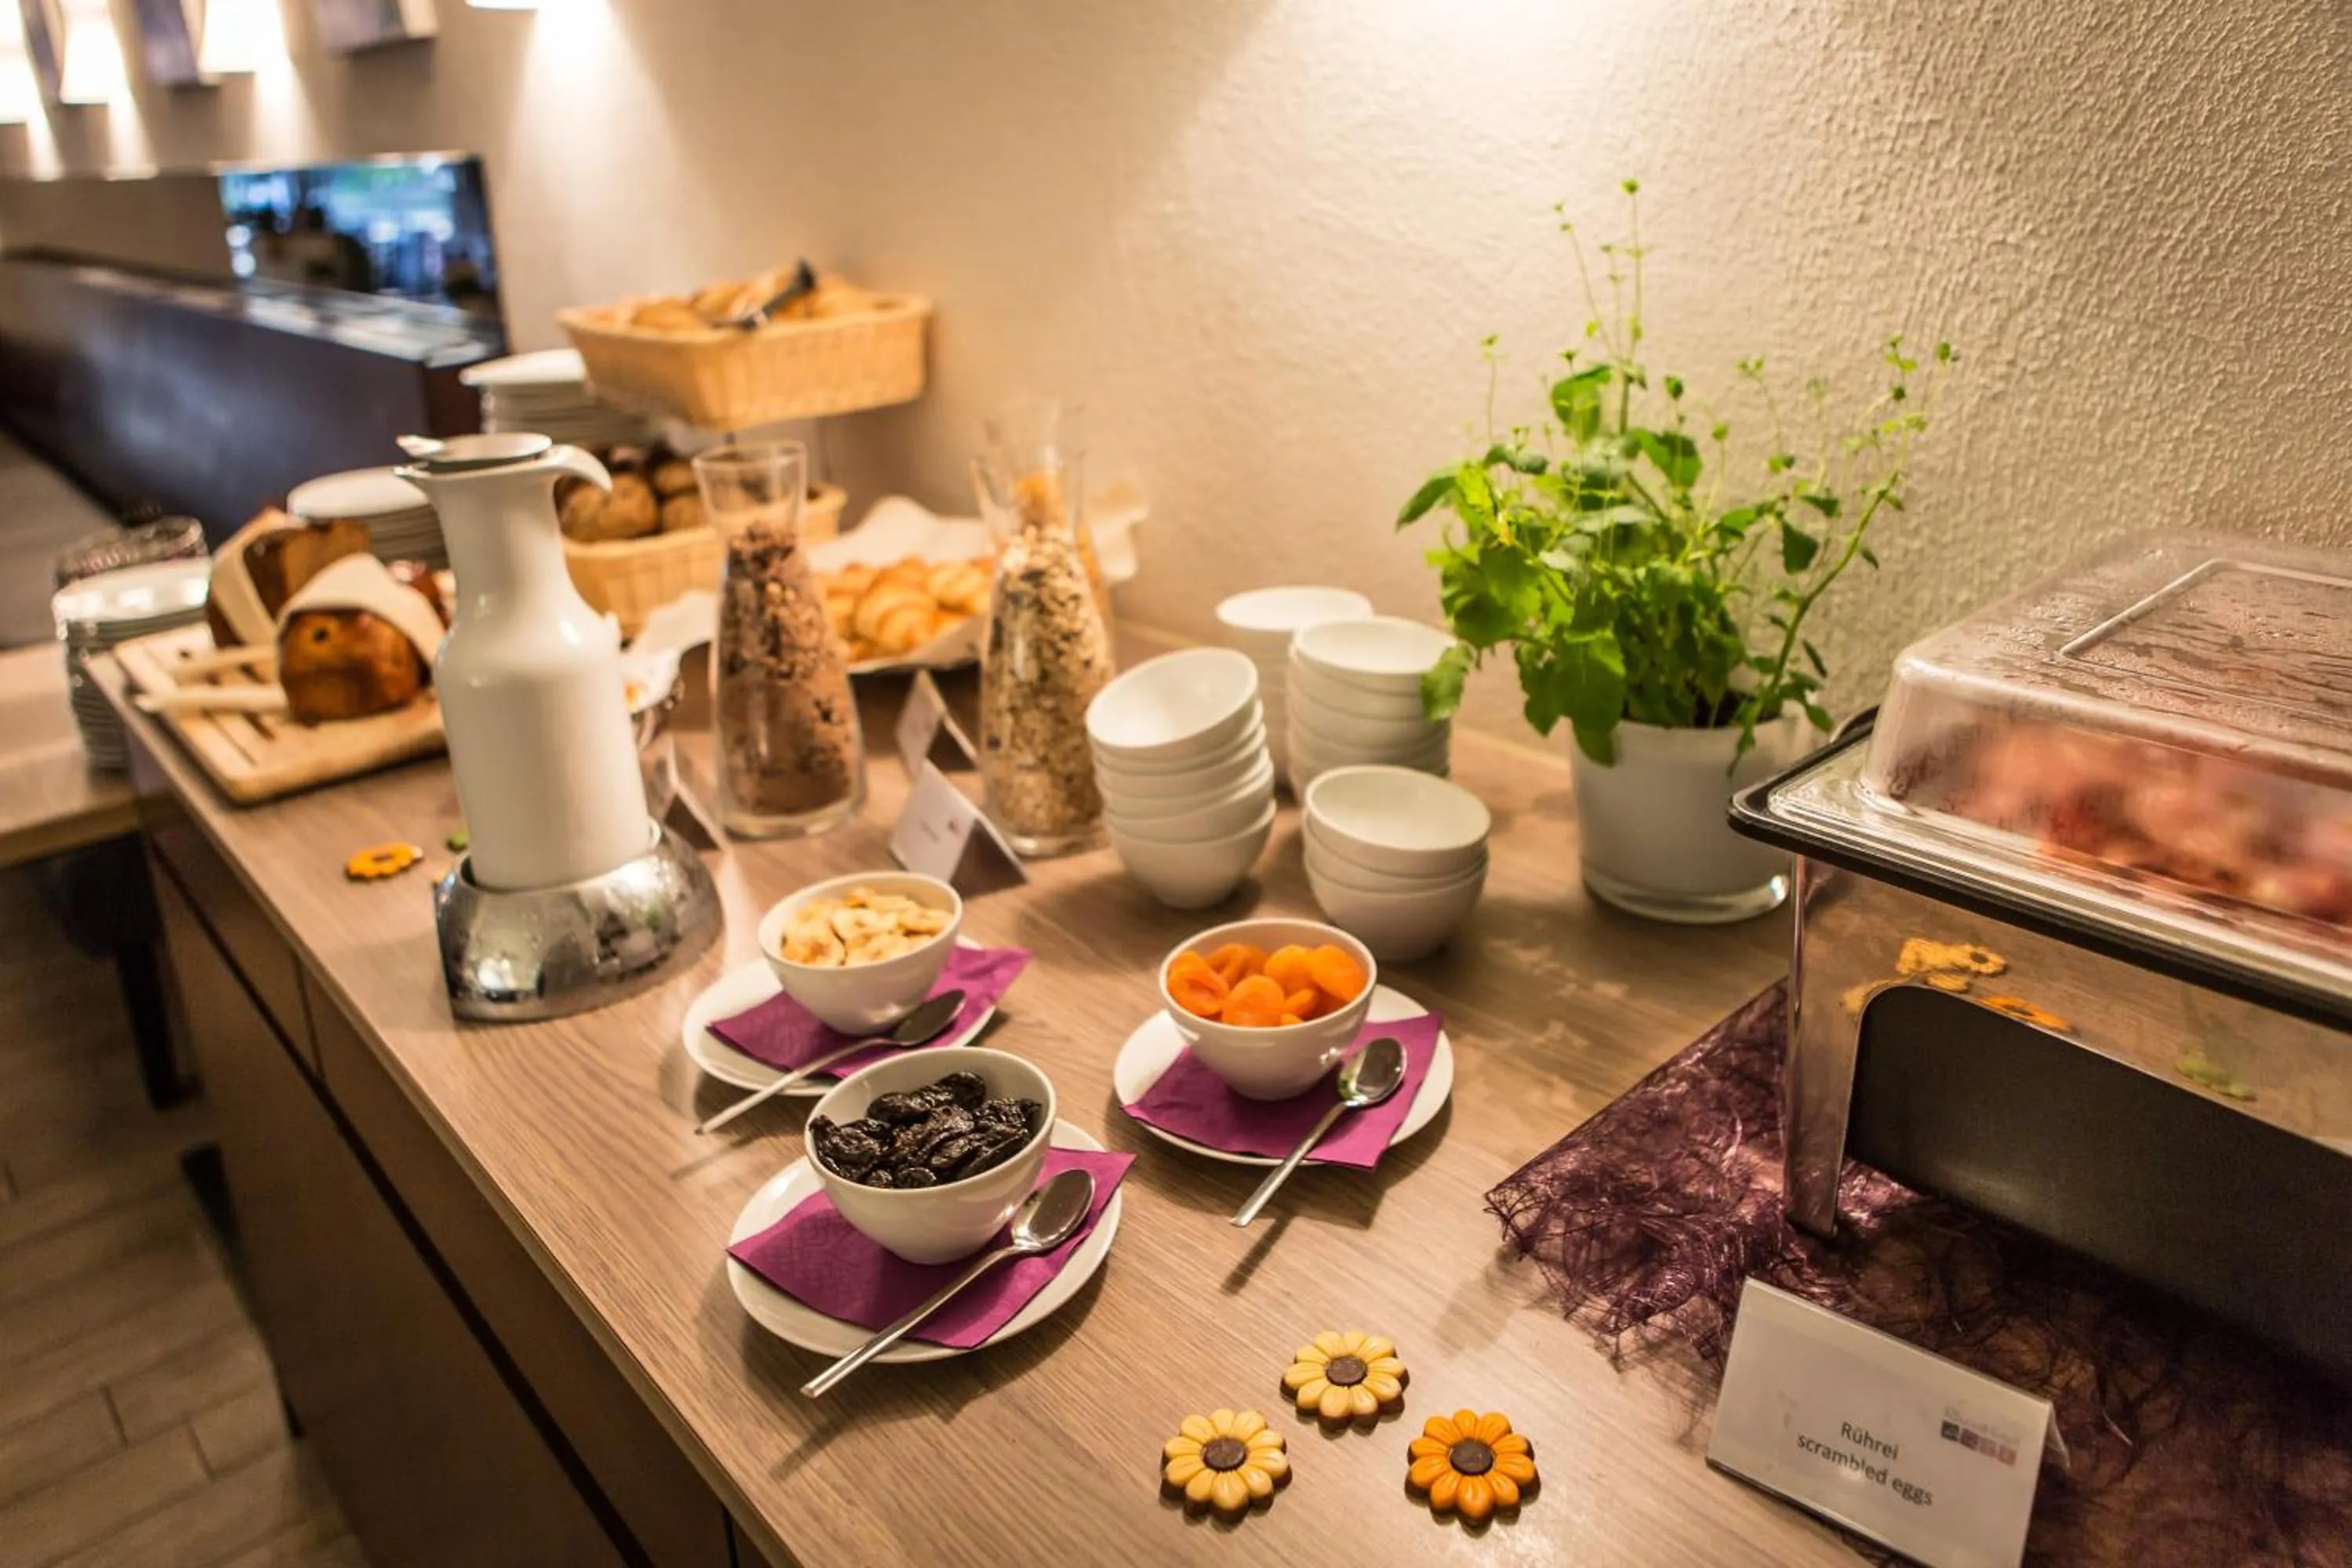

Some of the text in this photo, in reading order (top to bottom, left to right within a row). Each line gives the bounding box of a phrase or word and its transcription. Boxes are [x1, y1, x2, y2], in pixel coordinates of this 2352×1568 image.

[1841, 1421, 1899, 1460] Rührei
[1797, 1434, 1933, 1505] scrambled eggs
